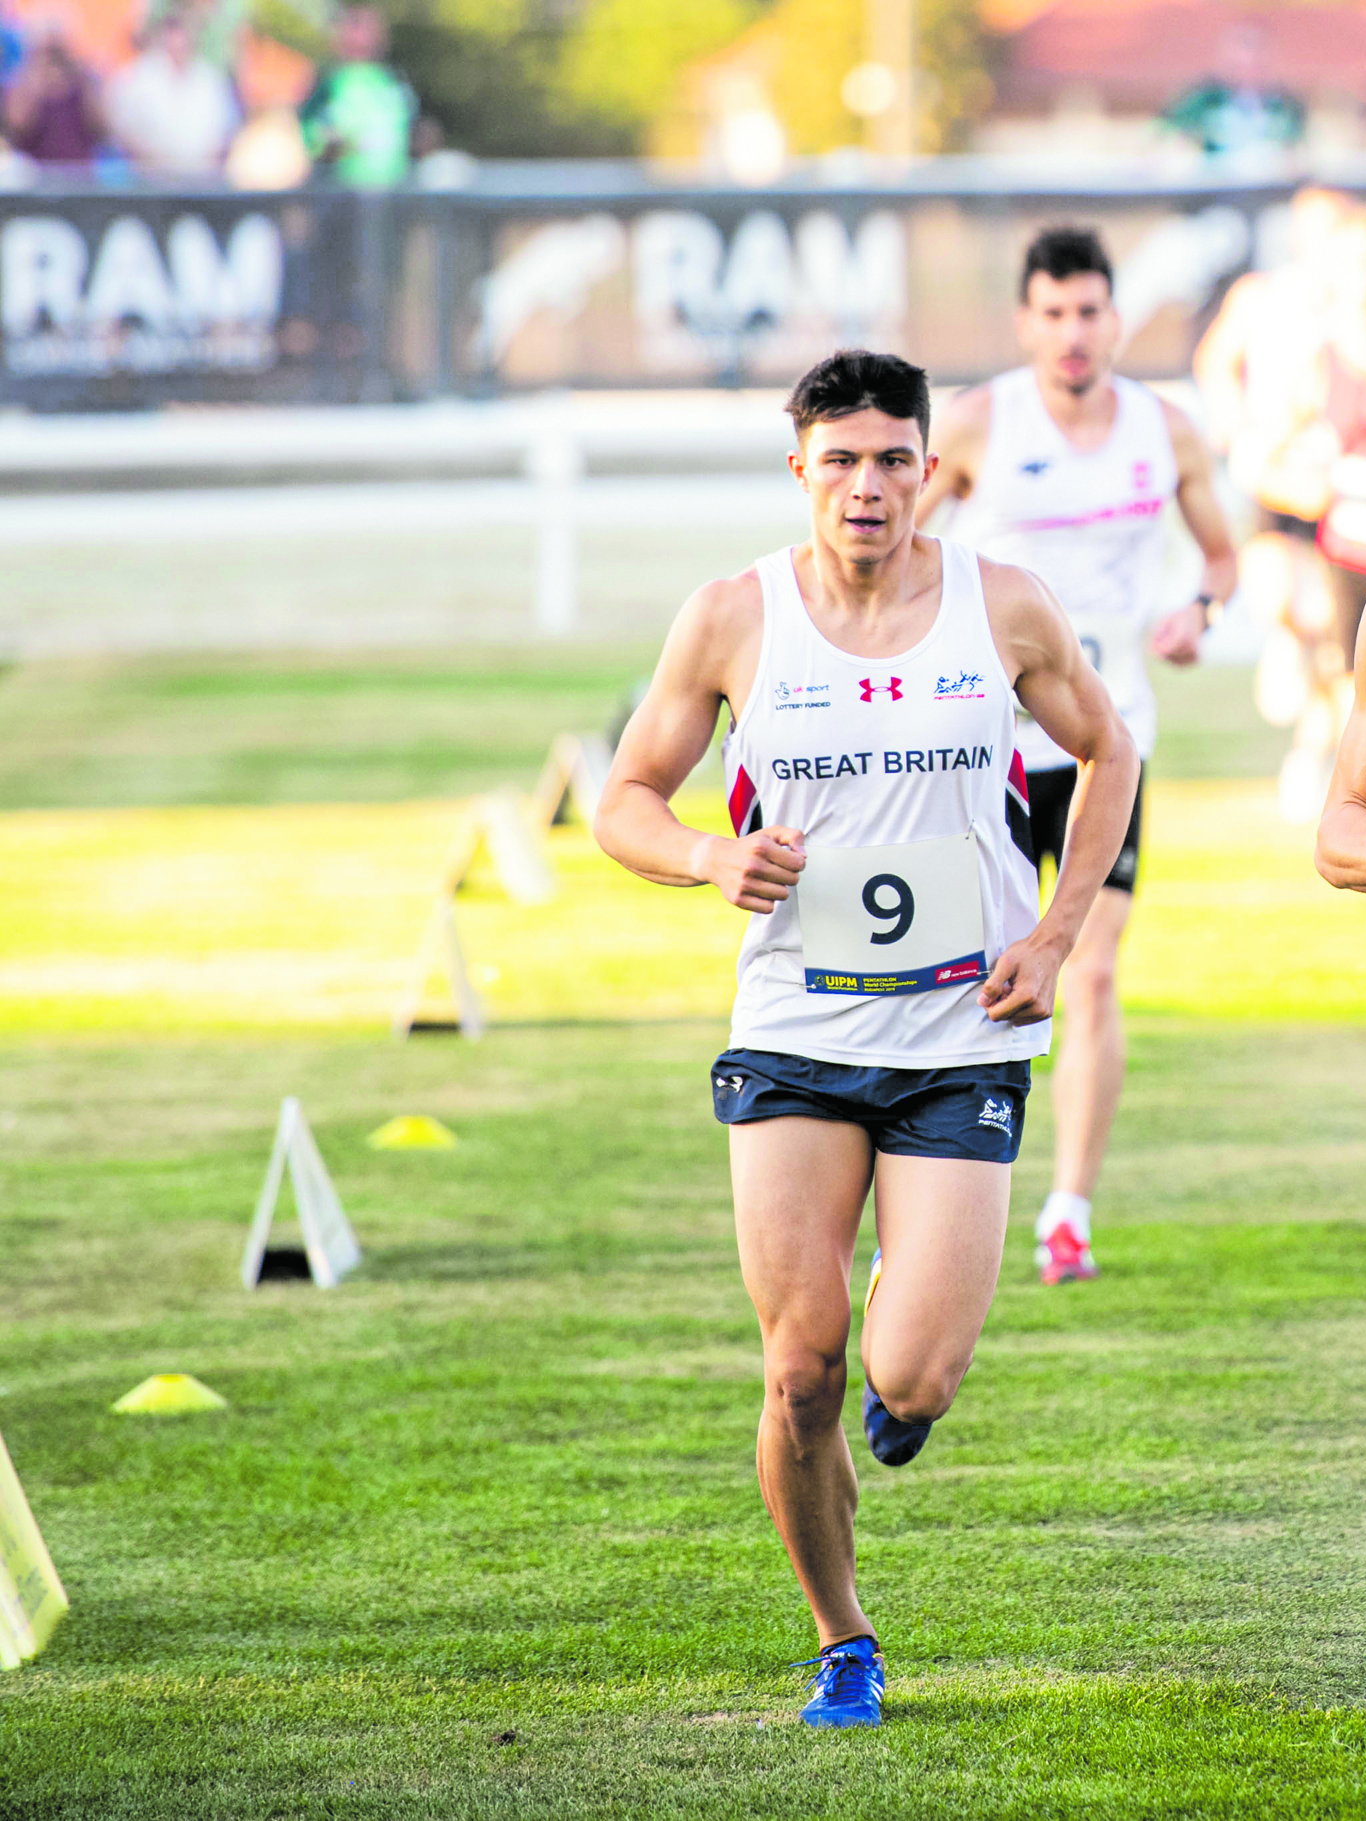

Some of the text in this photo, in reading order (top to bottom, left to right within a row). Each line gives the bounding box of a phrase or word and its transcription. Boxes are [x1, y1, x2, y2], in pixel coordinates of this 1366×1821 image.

[2, 214, 282, 337] RAM
[634, 210, 907, 333] RAM
[806, 684, 830, 693] sport
[805, 701, 831, 709] FUNDED
[772, 745, 993, 780] GREAT BRITAIN
[861, 873, 916, 946] 9
[825, 975, 858, 988] UIPM
[880, 980, 918, 988] Championships
